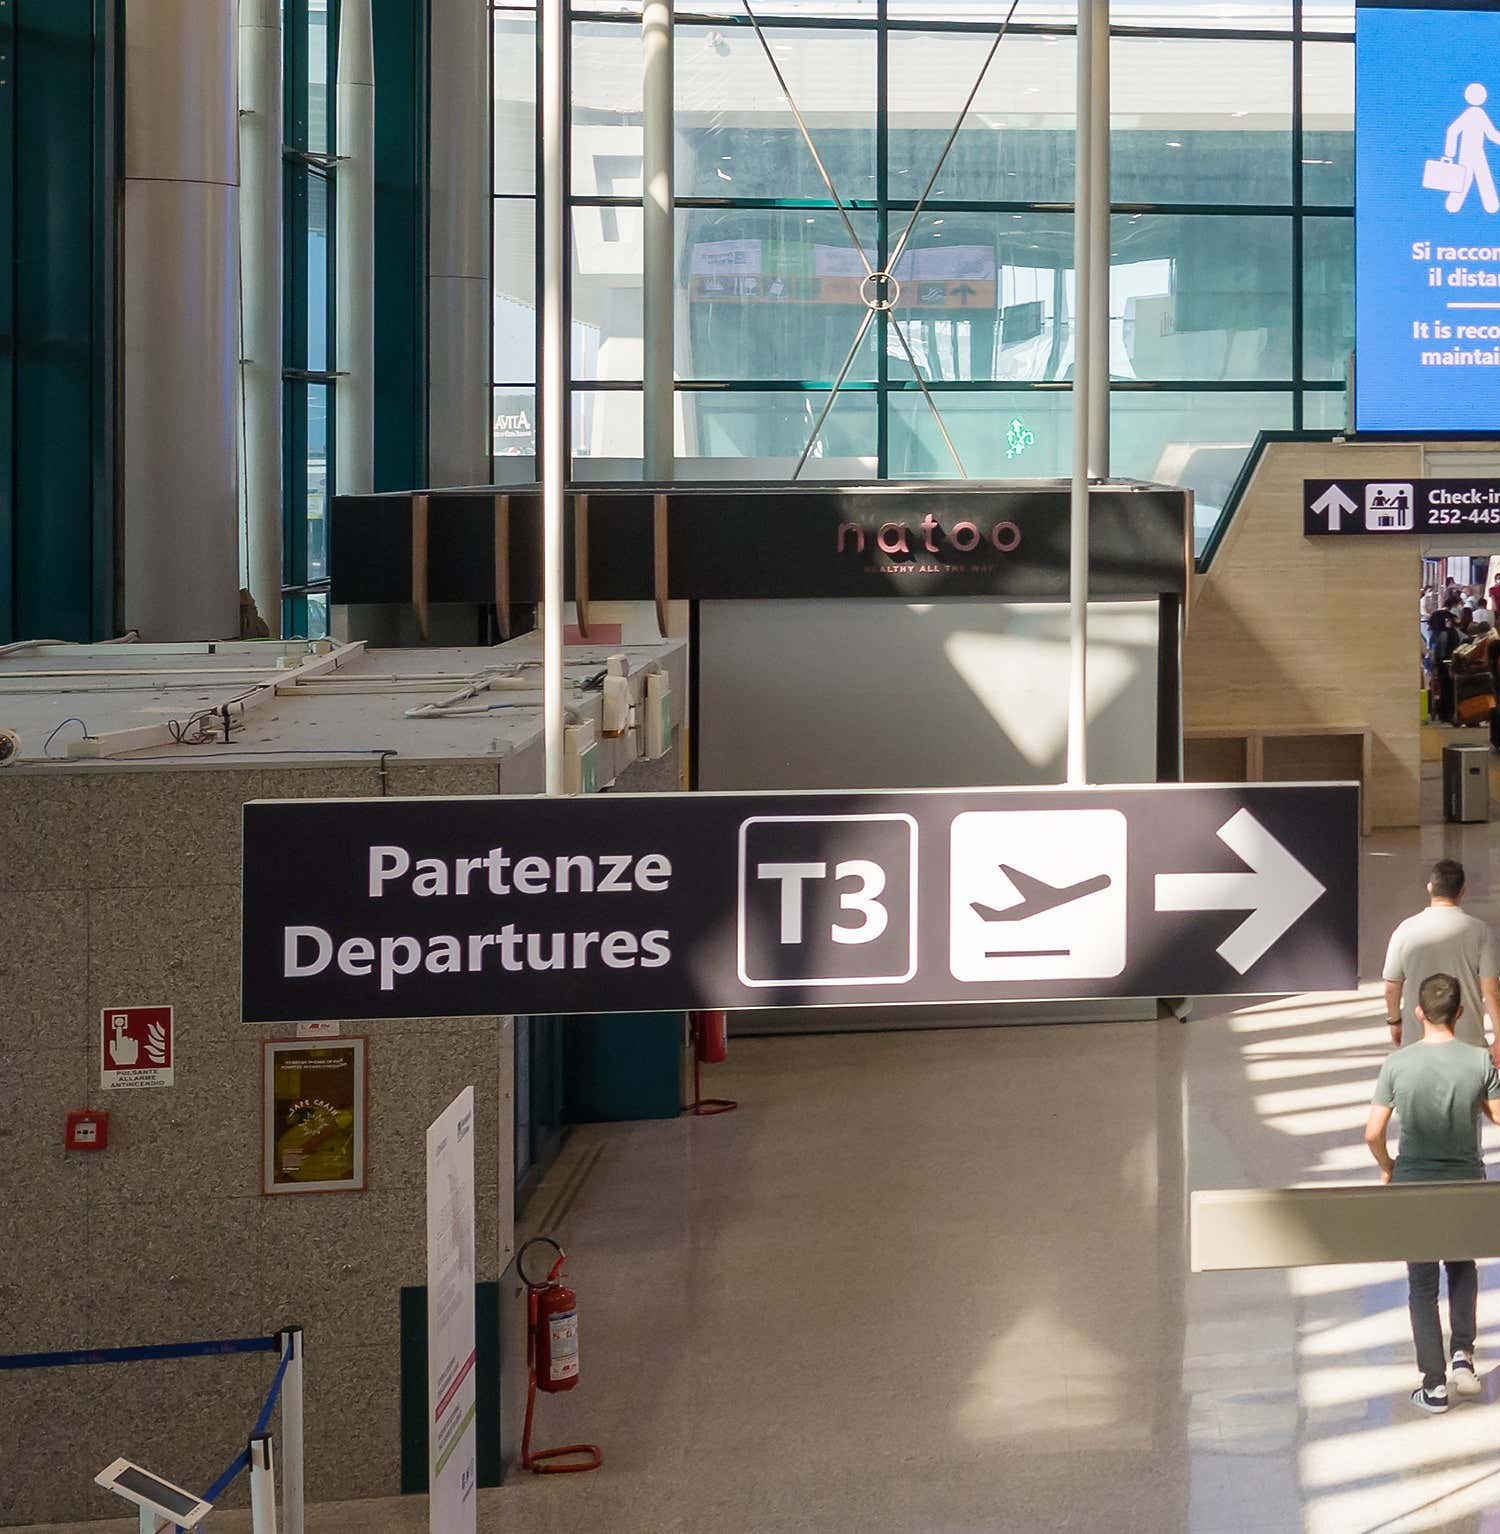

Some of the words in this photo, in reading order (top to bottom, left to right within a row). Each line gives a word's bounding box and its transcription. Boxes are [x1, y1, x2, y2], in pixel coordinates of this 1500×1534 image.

[1412, 242, 1431, 261] Si
[1429, 267, 1442, 287] il
[1413, 320, 1430, 339] It
[1434, 320, 1451, 339] is
[1428, 508, 1500, 525] 252-445
[837, 513, 1021, 554] natoo
[919, 565, 940, 573] ALL
[367, 846, 673, 897] Partenze
[757, 859, 889, 944] T3
[284, 922, 672, 991] Departures
